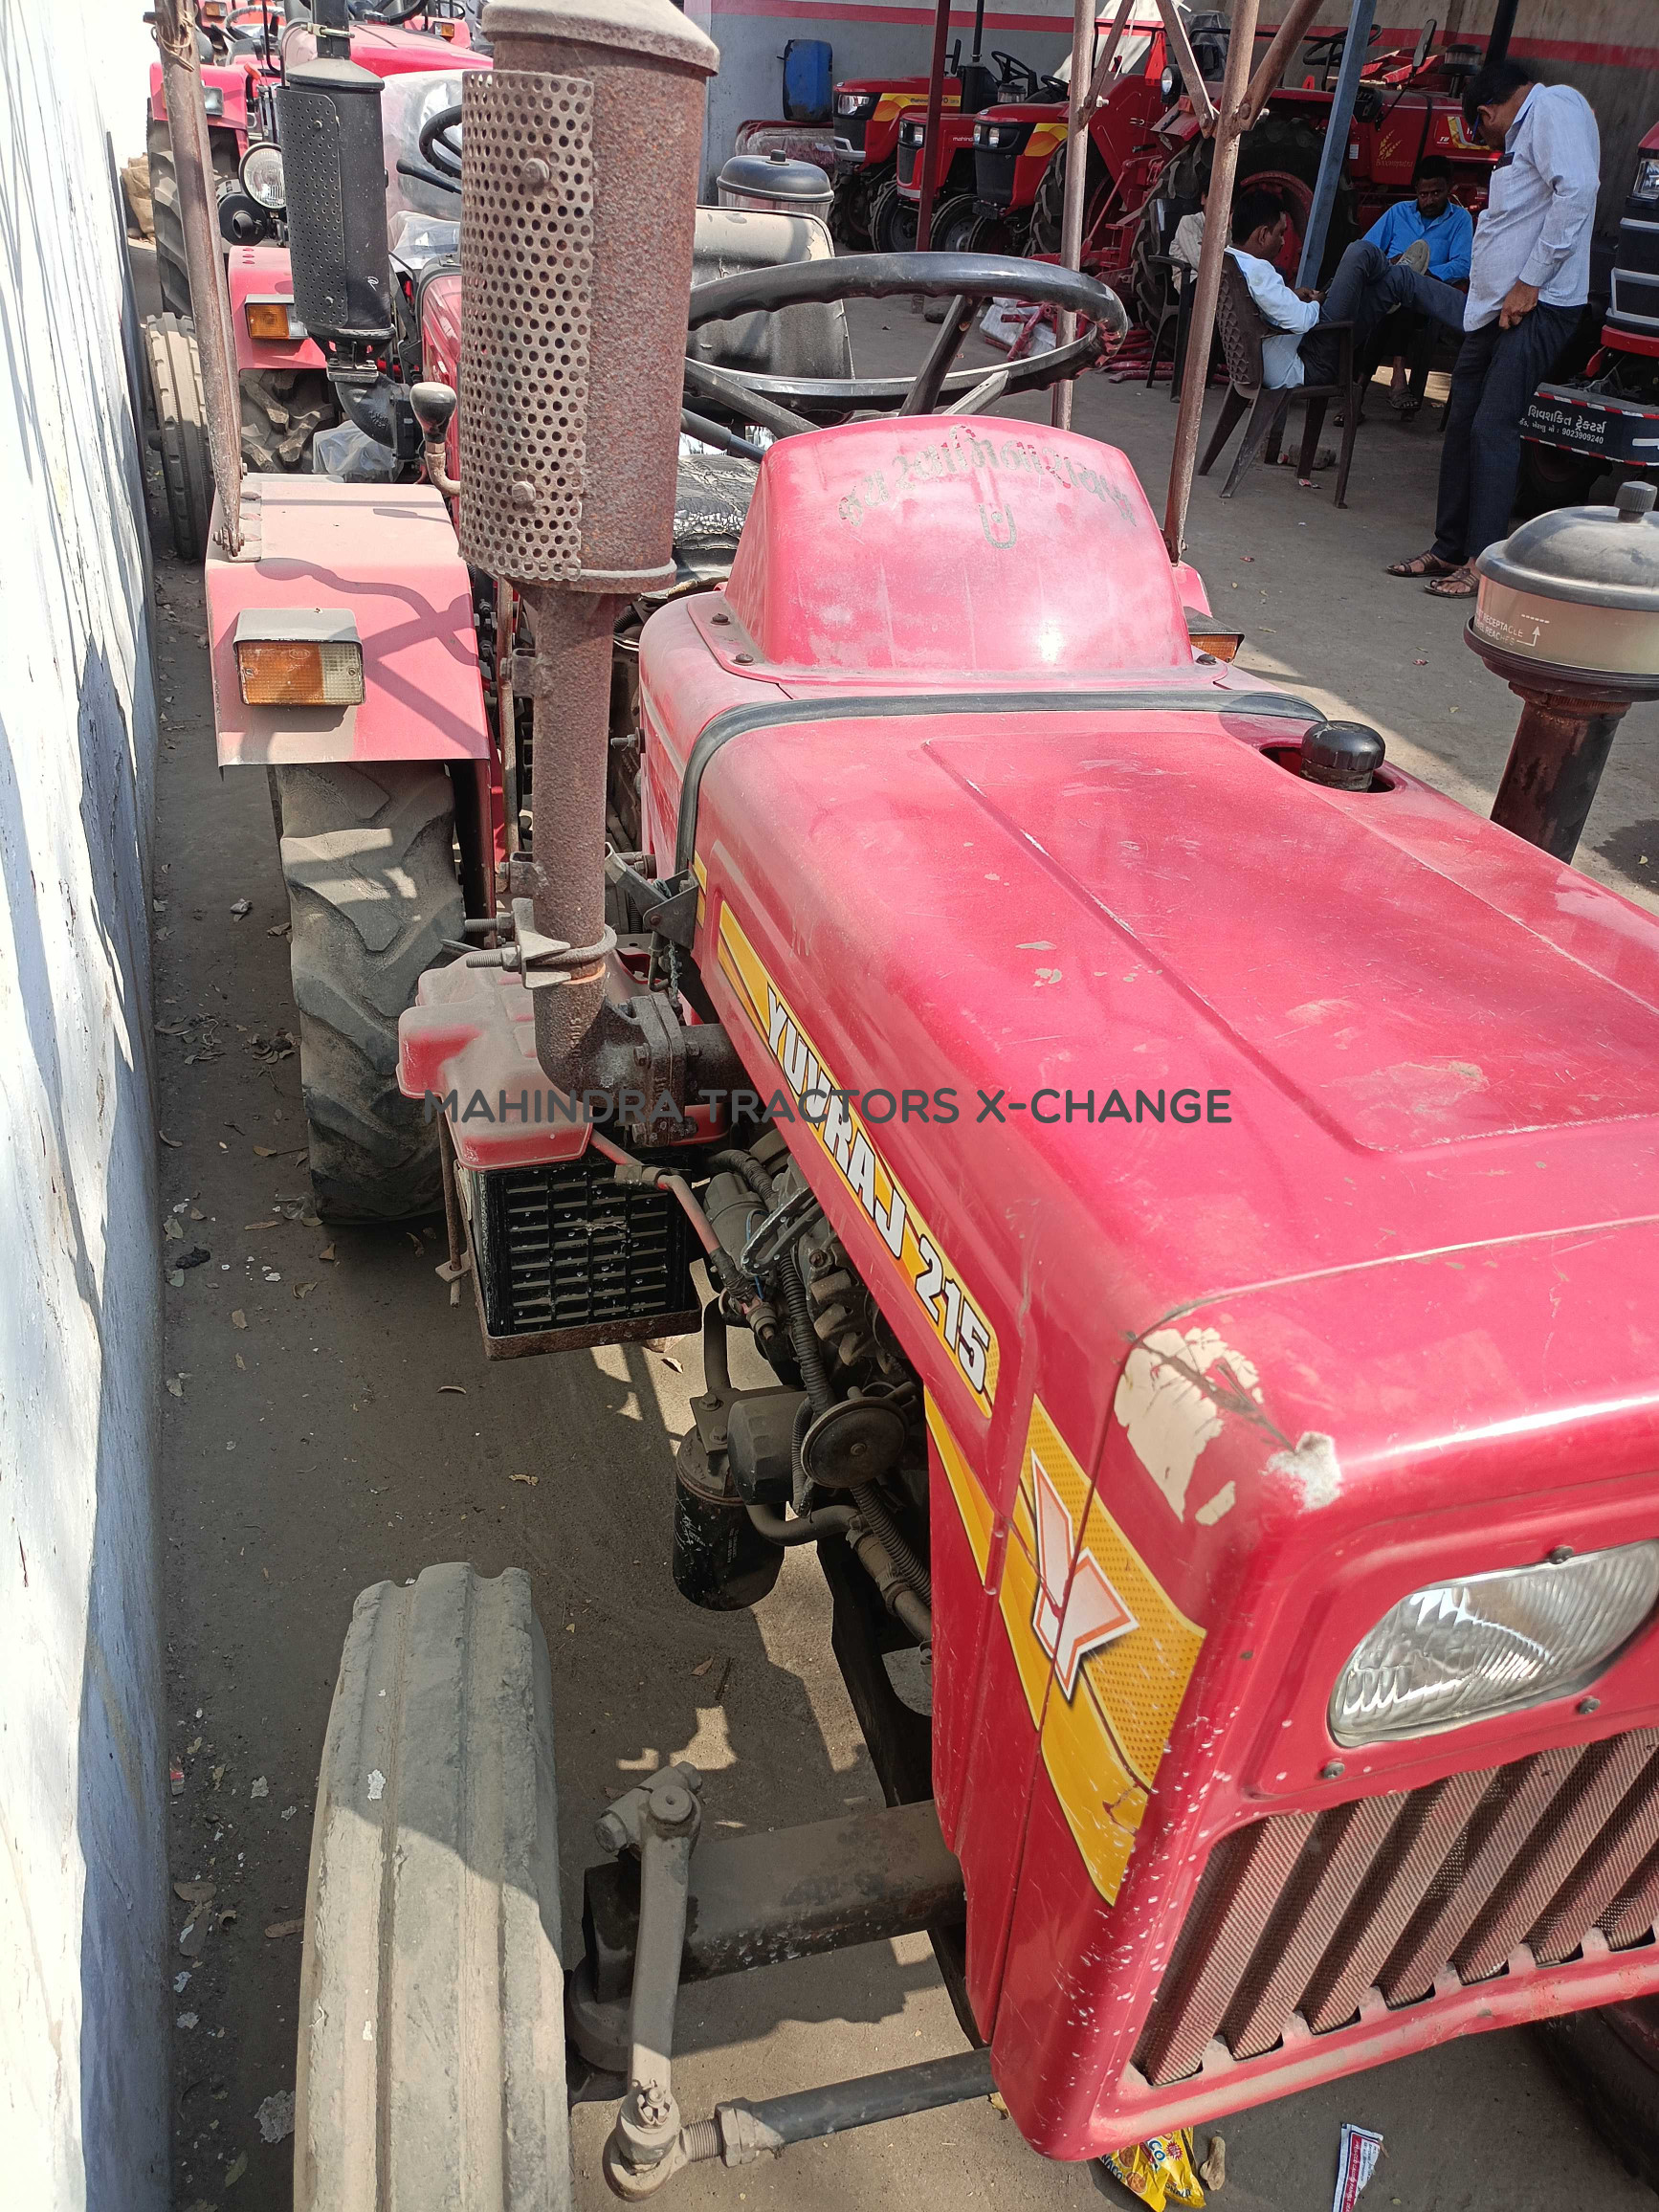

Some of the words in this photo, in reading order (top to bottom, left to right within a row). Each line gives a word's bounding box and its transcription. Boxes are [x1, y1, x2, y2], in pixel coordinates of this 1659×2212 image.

[1561, 428, 1604, 444] 9023909240
[767, 983, 907, 1259] YUVRAJ
[915, 1232, 990, 1393] 215
